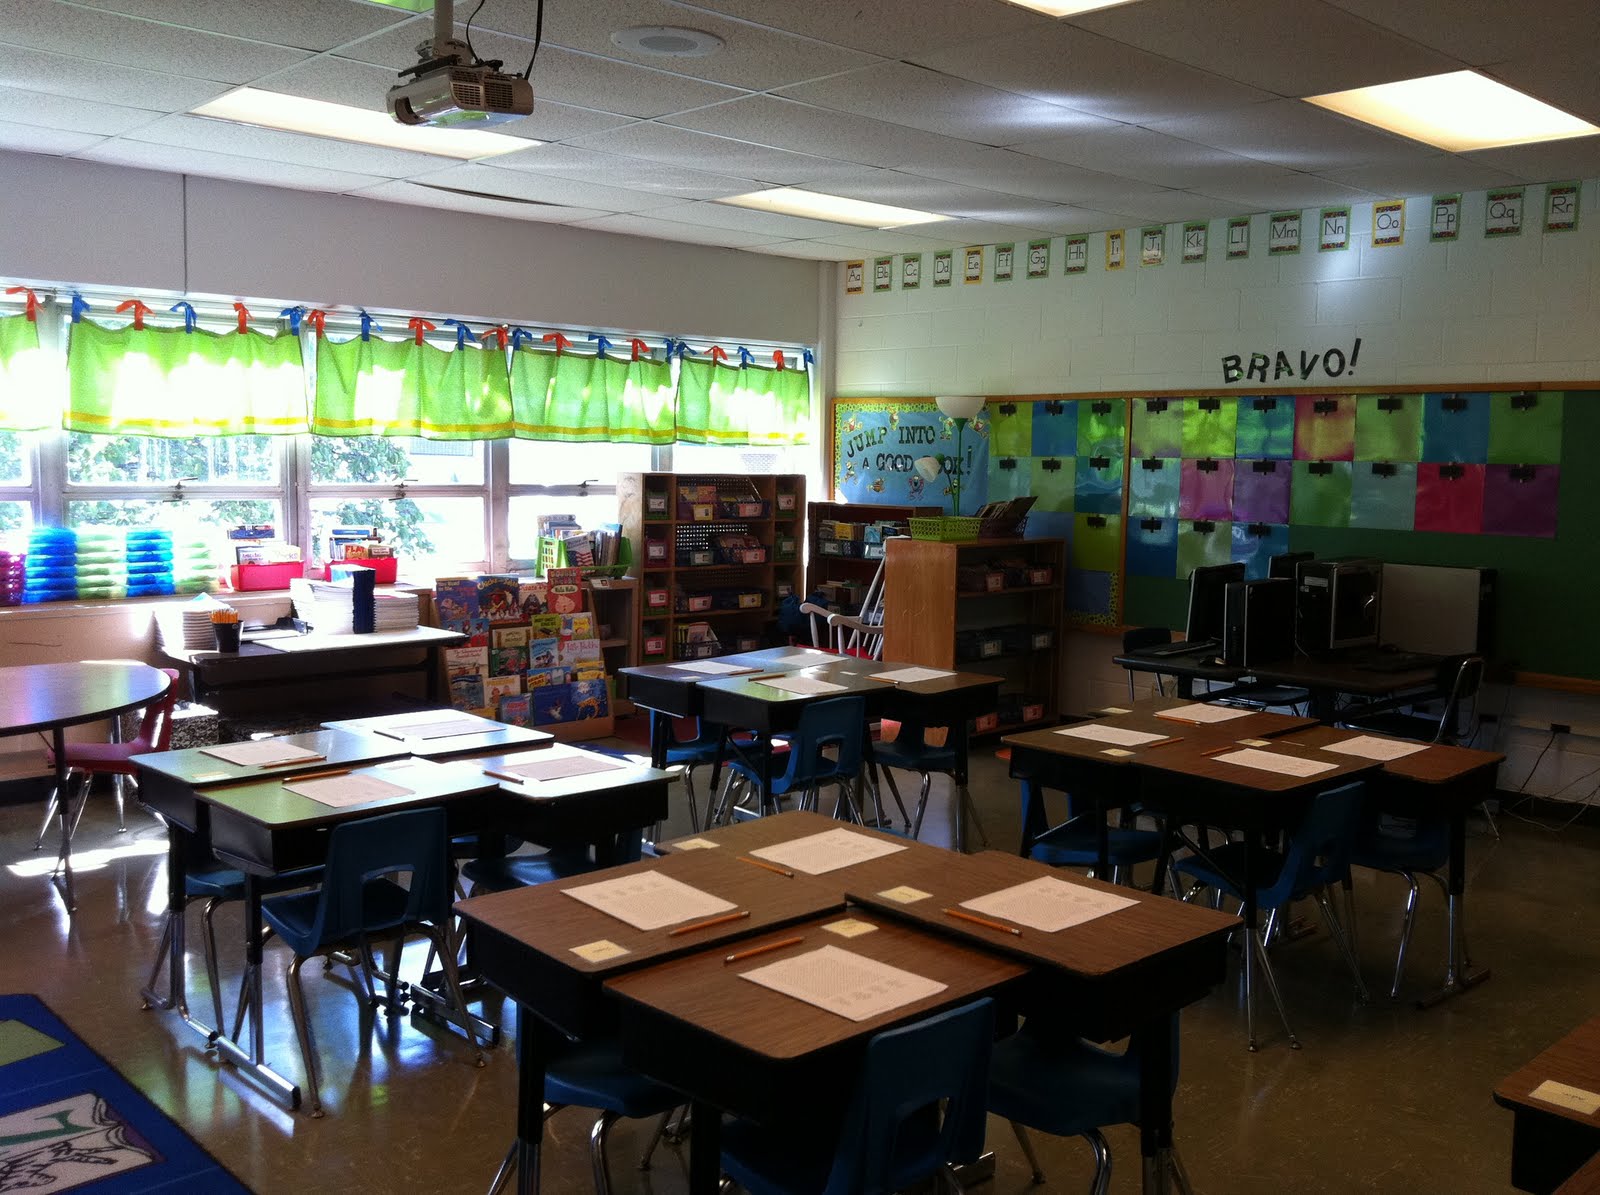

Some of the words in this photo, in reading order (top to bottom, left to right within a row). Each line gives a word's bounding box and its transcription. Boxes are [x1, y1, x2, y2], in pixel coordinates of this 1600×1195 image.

[1552, 196, 1574, 214] Rr
[1435, 207, 1456, 229] Pp
[1489, 202, 1519, 225] Qq
[1324, 220, 1345, 235] Nn
[1376, 213, 1399, 230] Oo
[1230, 229, 1246, 244] Ll
[1272, 224, 1298, 239] Mm
[1146, 238, 1160, 258] Jj
[1186, 234, 1203, 247] Kk
[998, 253, 1011, 268] Ff
[1030, 251, 1046, 269] Gg
[1069, 247, 1084, 260] Hh
[905, 264, 918, 276] Cc
[936, 261, 950, 274] Dd
[967, 257, 980, 269] Ee
[848, 270, 861, 281] Aa
[877, 267, 889, 279] Bb
[1221, 338, 1361, 384] BRAVO!
[846, 426, 887, 458] JUMP
[898, 425, 936, 445] INTO
[862, 457, 870, 470] A
[876, 452, 914, 472] GOOD
[922, 445, 972, 475] OK!
